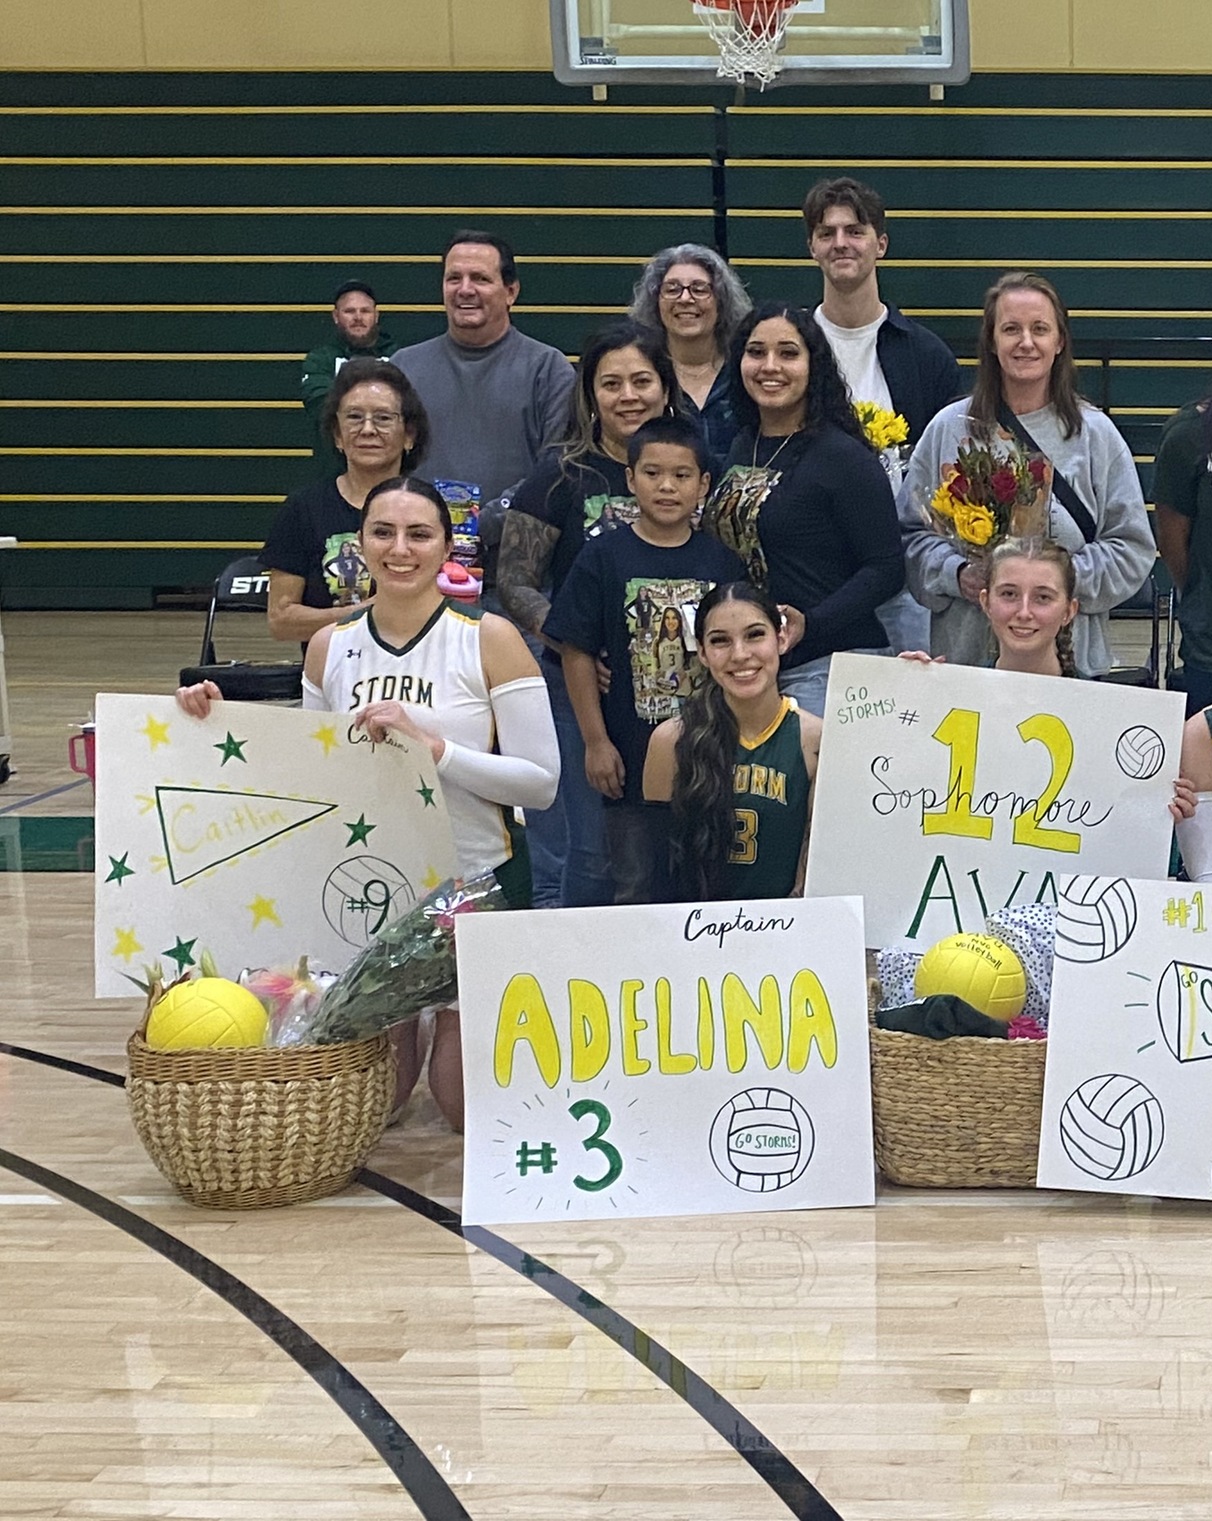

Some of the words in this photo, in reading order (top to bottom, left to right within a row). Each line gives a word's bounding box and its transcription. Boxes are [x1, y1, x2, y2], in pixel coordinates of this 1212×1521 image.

[348, 675, 434, 712] STORM
[836, 697, 897, 725] STORMS!
[844, 686, 869, 702] GO
[869, 755, 1115, 828] Sophomore
[727, 808, 759, 865] 3
[346, 879, 391, 935] #9
[684, 907, 795, 948] Captain
[493, 968, 838, 1089] ADELINA
[515, 1098, 624, 1193] #3
[735, 1133, 752, 1149] GO
[754, 1134, 797, 1150] STORMS!
